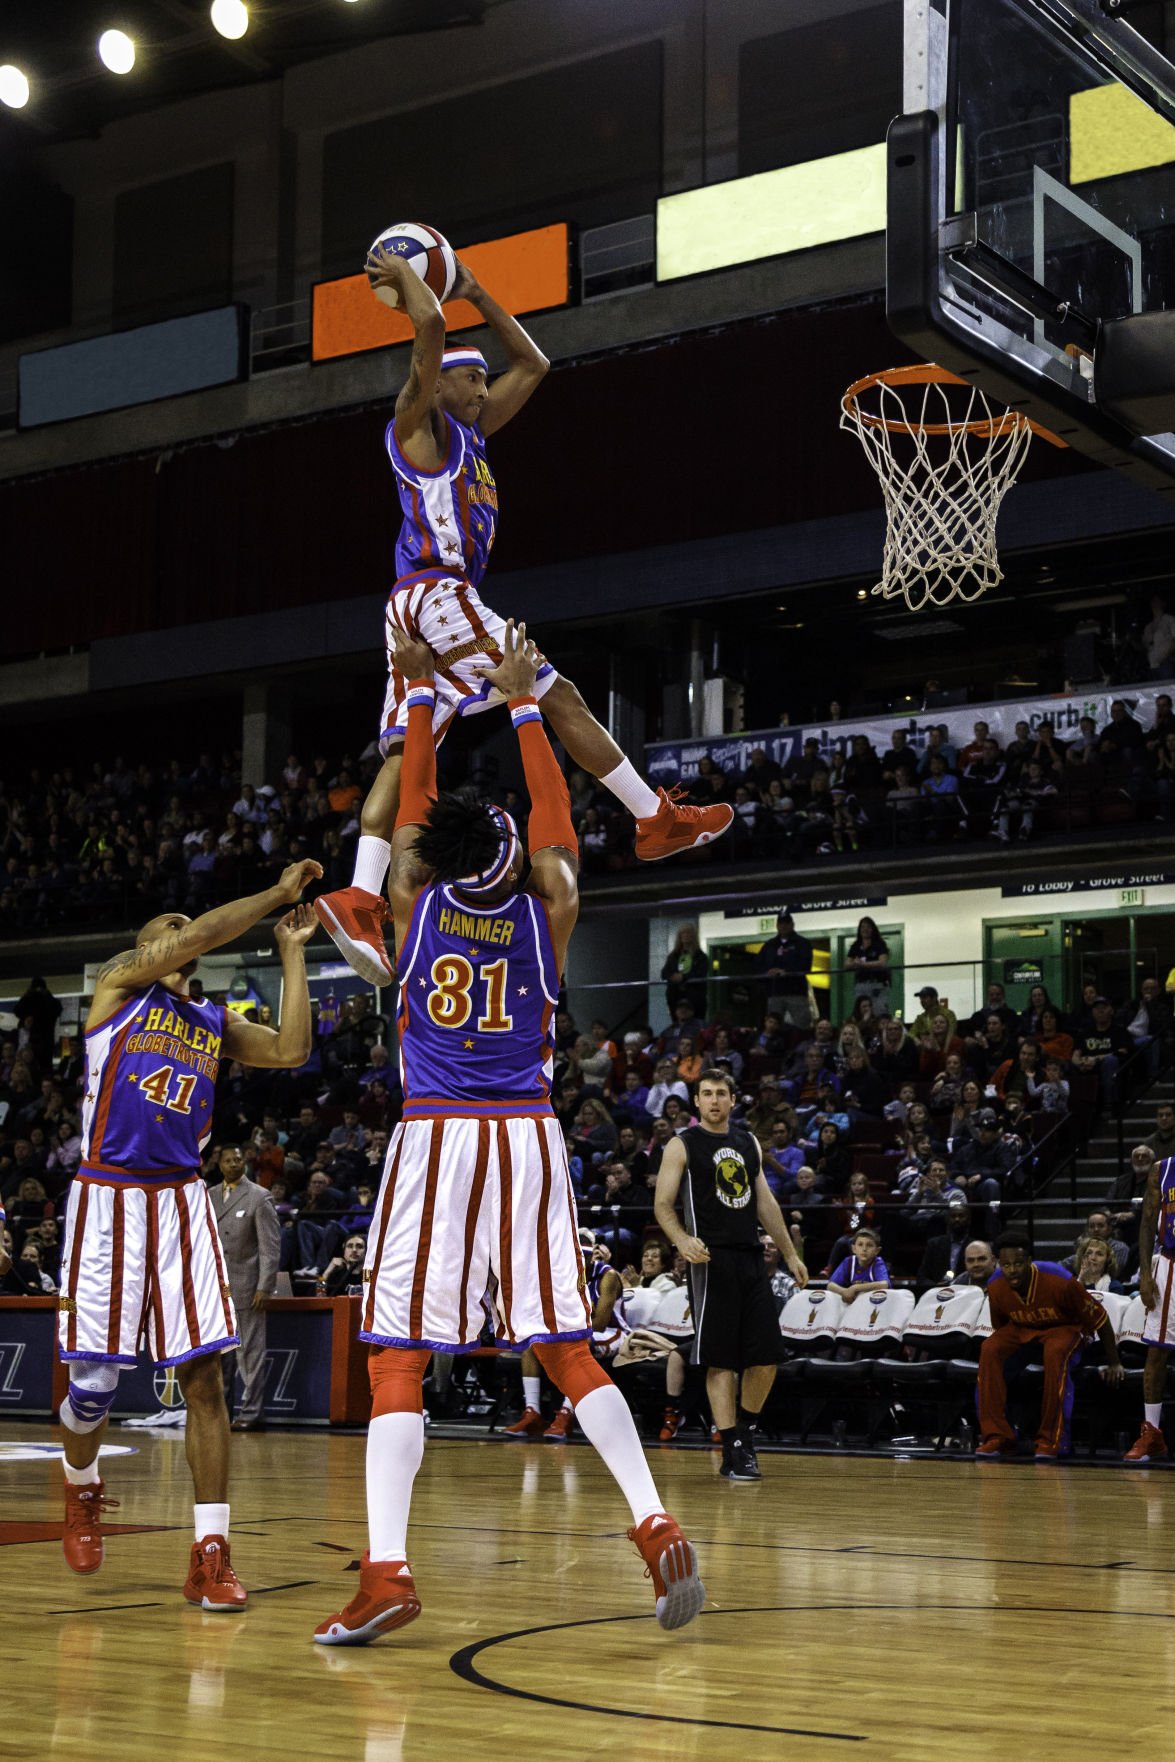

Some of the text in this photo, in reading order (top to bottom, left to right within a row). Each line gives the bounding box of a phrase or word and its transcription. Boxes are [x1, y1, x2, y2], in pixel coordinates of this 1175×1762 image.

[772, 738, 793, 768] 17
[1121, 889, 1138, 904] EXIT
[438, 907, 515, 946] HAMMER
[427, 953, 513, 1032] 31
[144, 1008, 222, 1059] HARLEM
[126, 1033, 219, 1084] GLOBETROTTER
[139, 1065, 198, 1115] 41
[712, 1146, 745, 1166] WORLD
